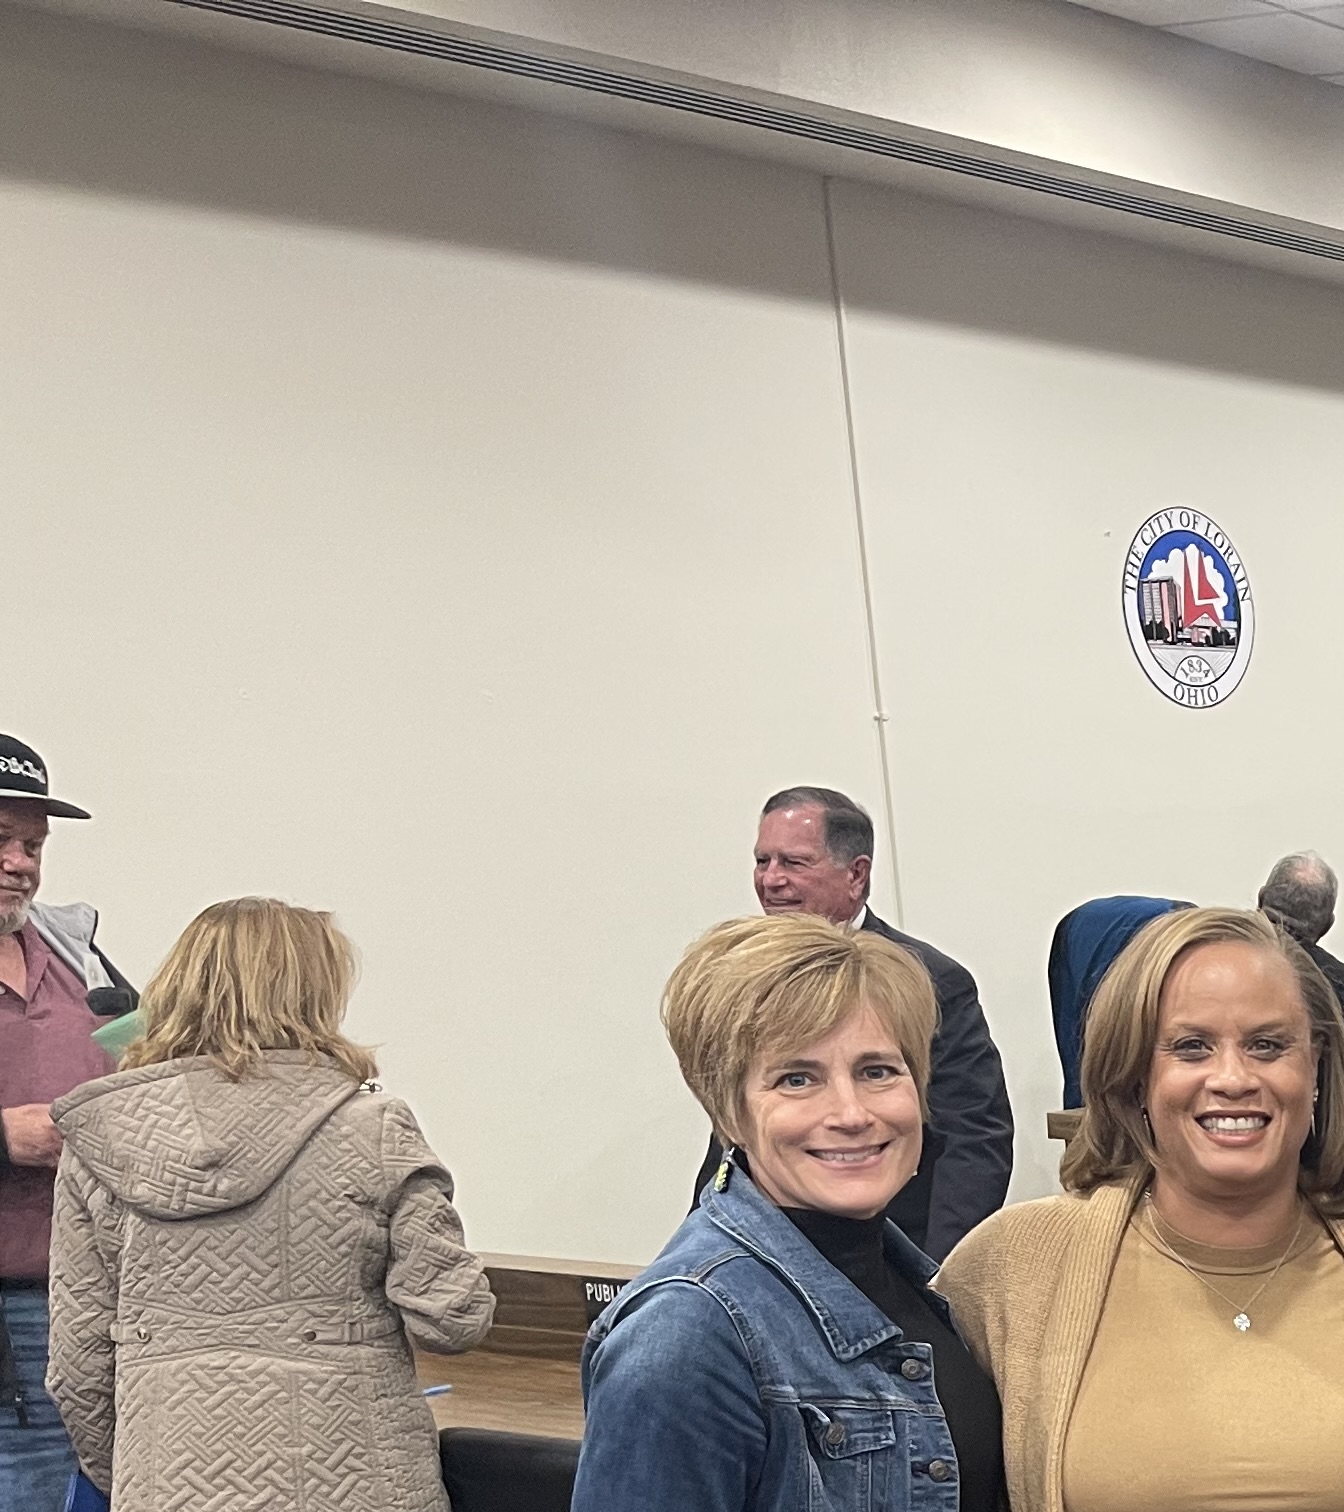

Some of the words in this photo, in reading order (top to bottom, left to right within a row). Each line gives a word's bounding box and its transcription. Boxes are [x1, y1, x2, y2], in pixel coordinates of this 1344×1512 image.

[1123, 545, 1144, 594] THE
[1140, 511, 1174, 546] CITY
[1179, 511, 1201, 531] OF
[1203, 522, 1251, 602] LORAIN
[1173, 683, 1219, 706] OHIO
[585, 1282, 622, 1303] PUBLI
